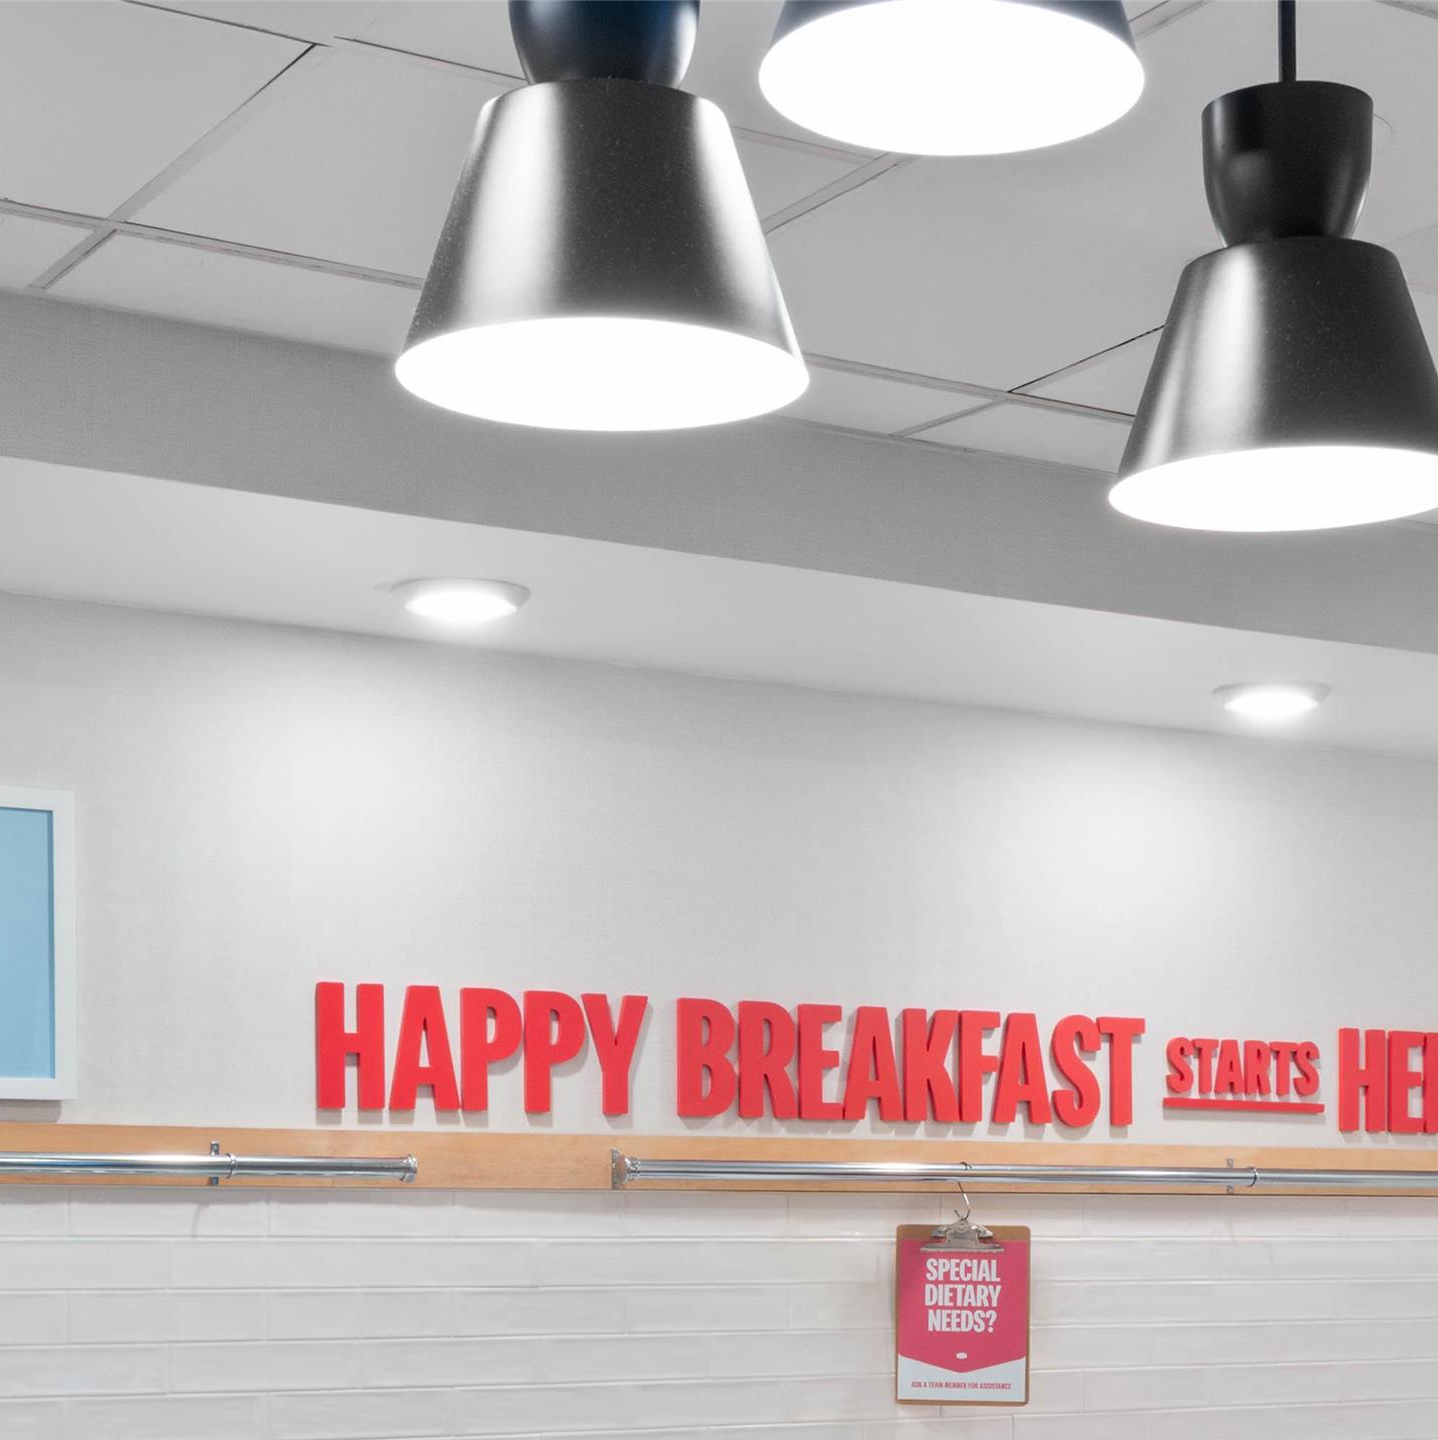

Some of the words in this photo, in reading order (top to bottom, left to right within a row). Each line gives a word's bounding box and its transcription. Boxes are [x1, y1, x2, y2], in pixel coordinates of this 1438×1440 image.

[316, 982, 648, 1115] HAPPY
[677, 998, 1145, 1127] BREAKFAST
[1166, 1037, 1320, 1096] STARTS
[925, 1258, 1001, 1282] SPECIAL
[924, 1284, 1002, 1307] DIETARY
[927, 1309, 997, 1333] NEEDS?
